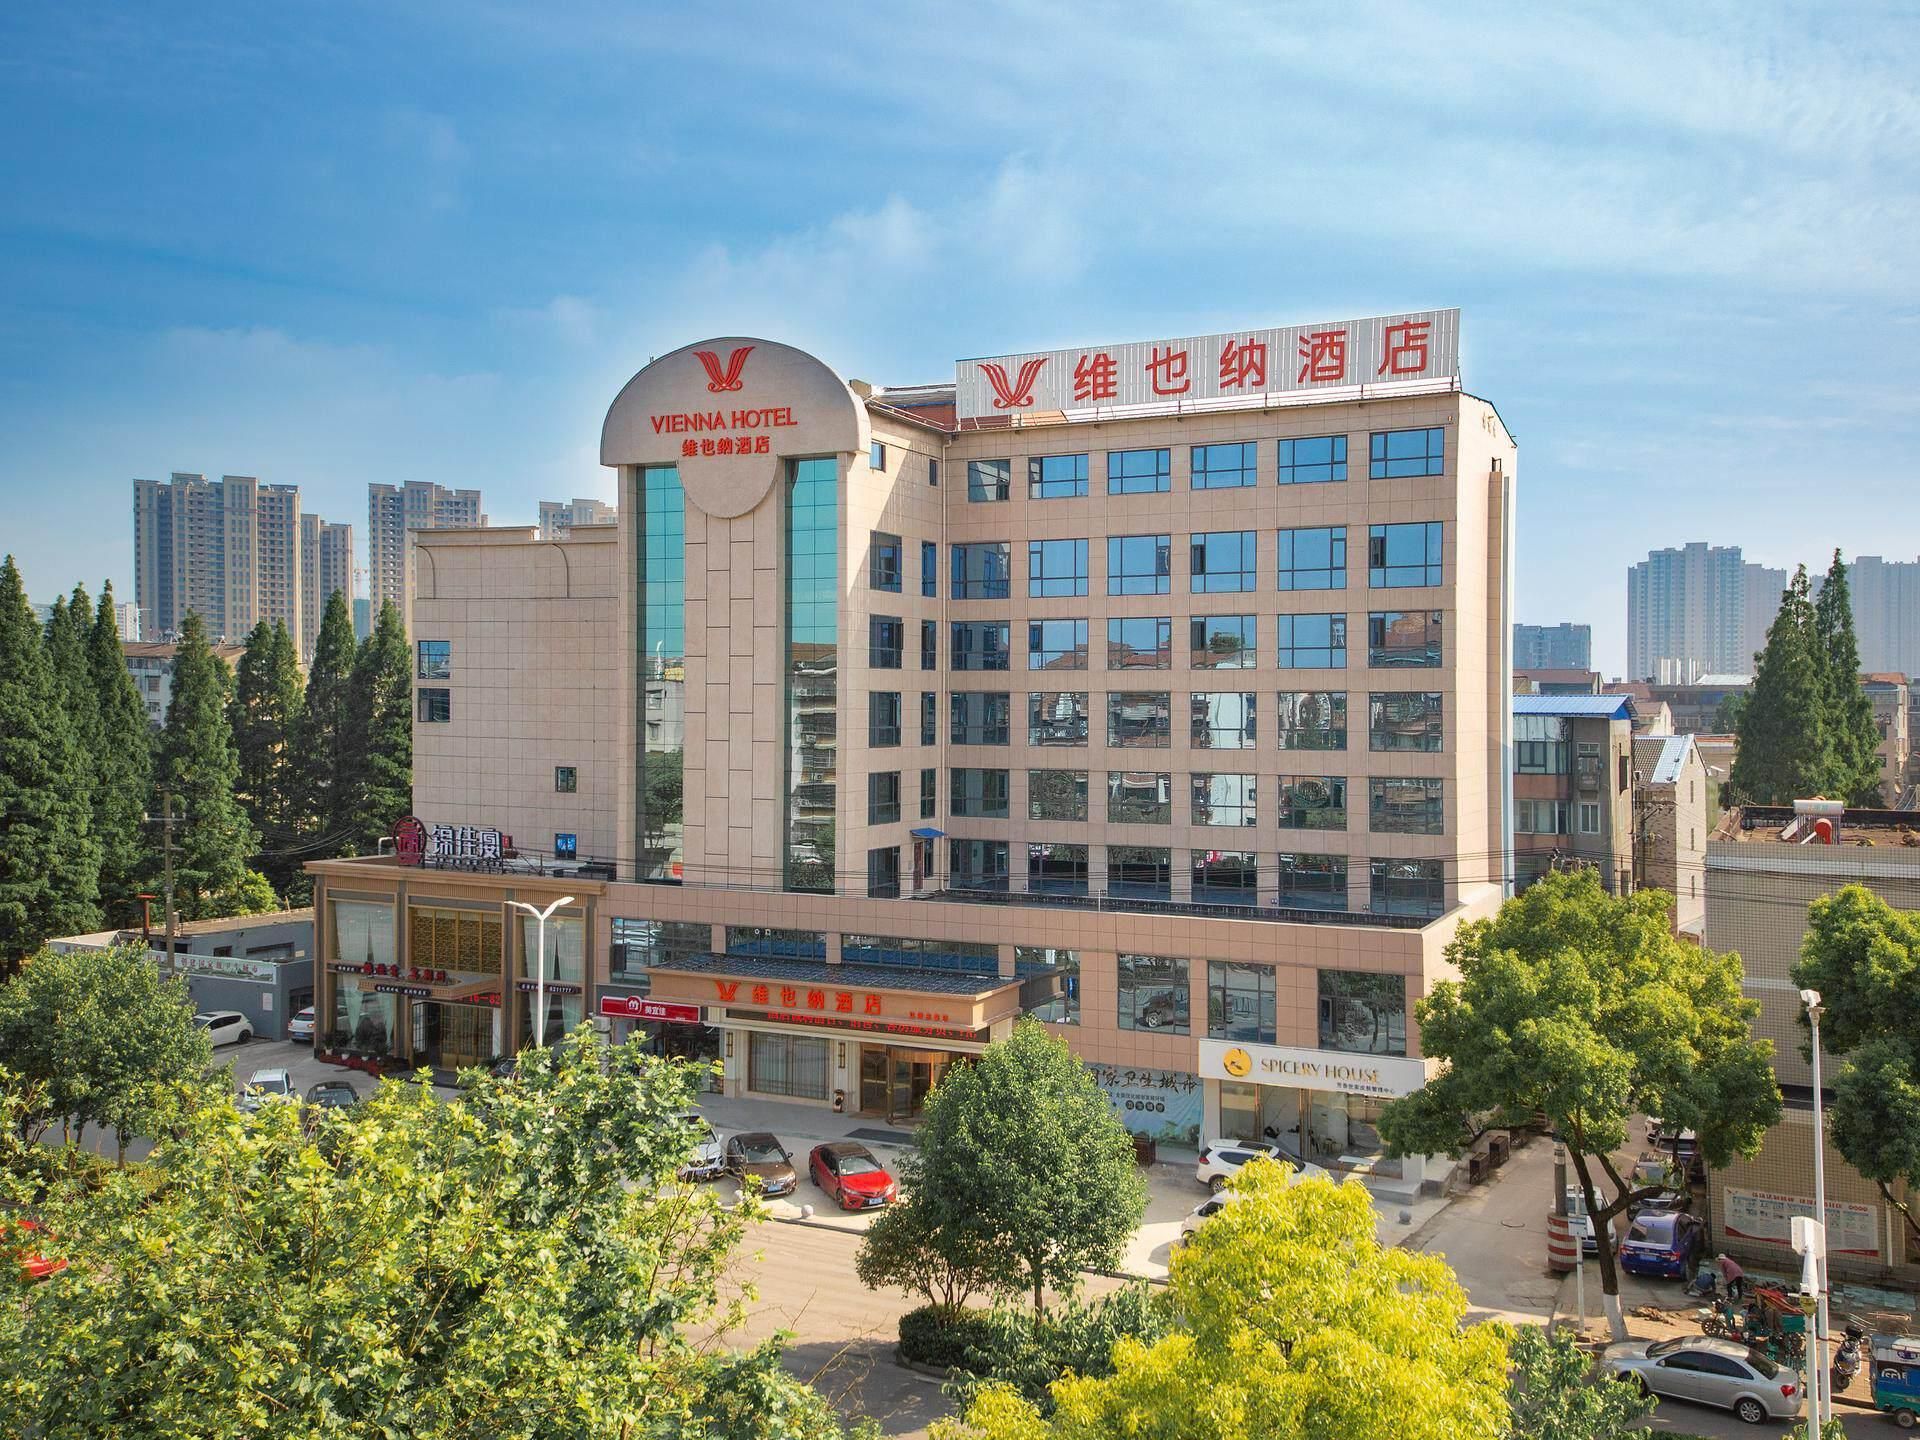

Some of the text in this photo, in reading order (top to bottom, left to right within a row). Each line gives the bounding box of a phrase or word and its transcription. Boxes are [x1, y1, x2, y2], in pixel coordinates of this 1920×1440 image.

[1073, 320, 1433, 401] 维也纳酒店
[650, 407, 798, 434] VIENNA HOTEL
[681, 435, 770, 457] 维也纳酒店
[751, 983, 882, 1016] 维也纳酒店
[1260, 1057, 1380, 1084] SPICERY HOUSE
